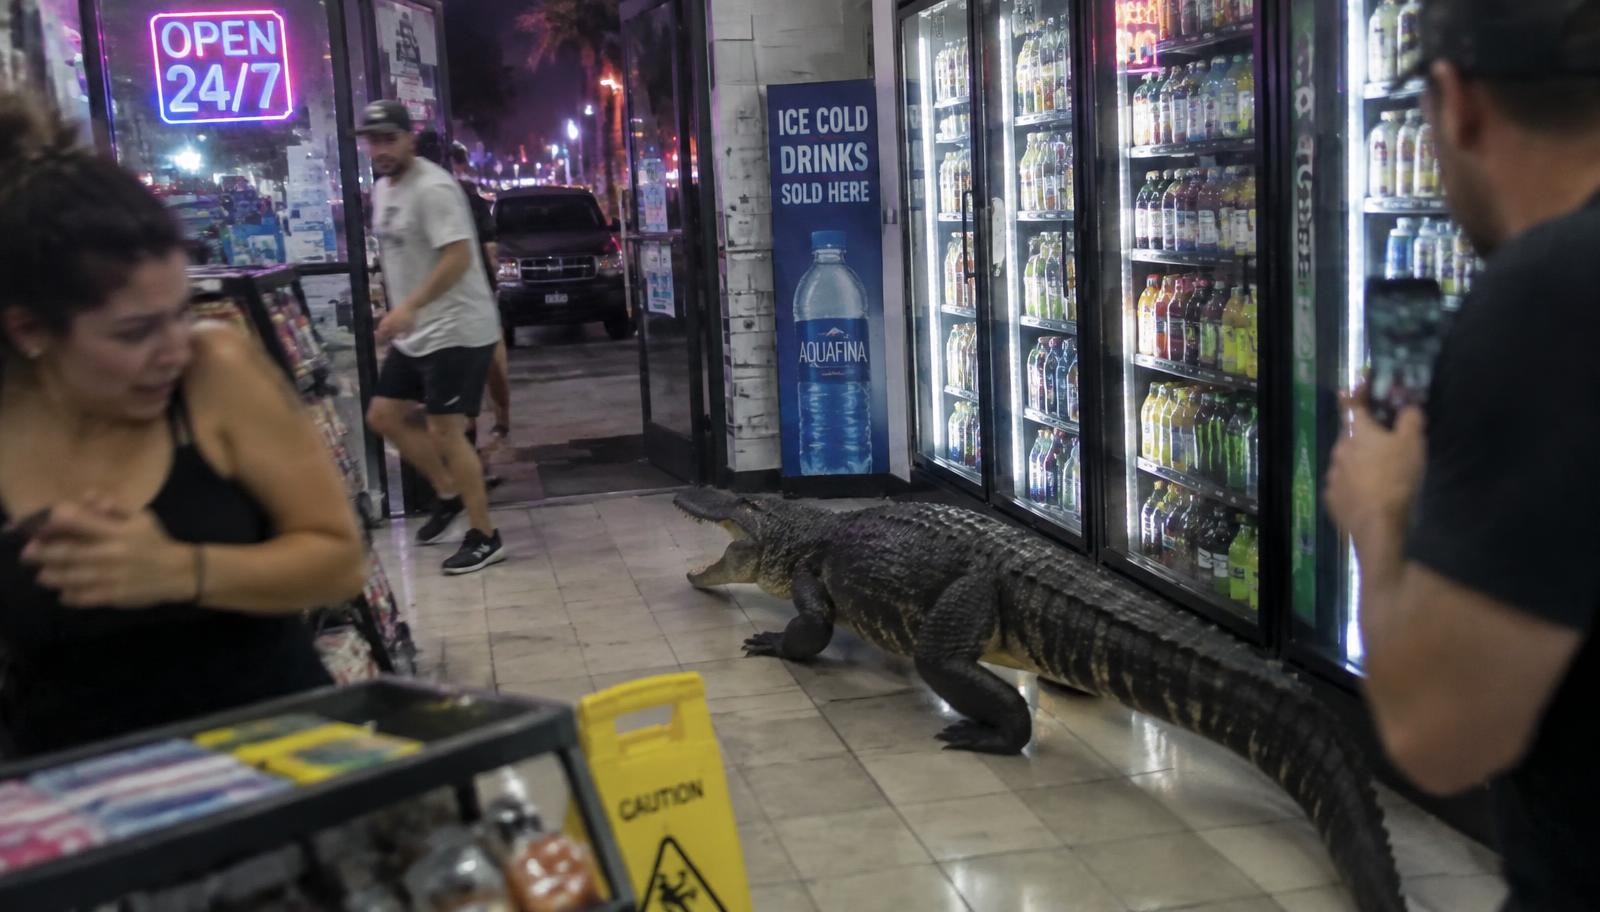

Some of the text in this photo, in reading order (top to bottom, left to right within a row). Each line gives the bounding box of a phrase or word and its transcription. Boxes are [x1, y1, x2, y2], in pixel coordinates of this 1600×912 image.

[161, 20, 276, 58] OPEN
[166, 62, 281, 112] 24/7
[778, 105, 868, 136] ICE COLD
[780, 142, 869, 174] DRINKS
[781, 181, 870, 205] SOLD HERE
[799, 341, 868, 364] AQUAFINA
[619, 779, 704, 821] CAUTION
